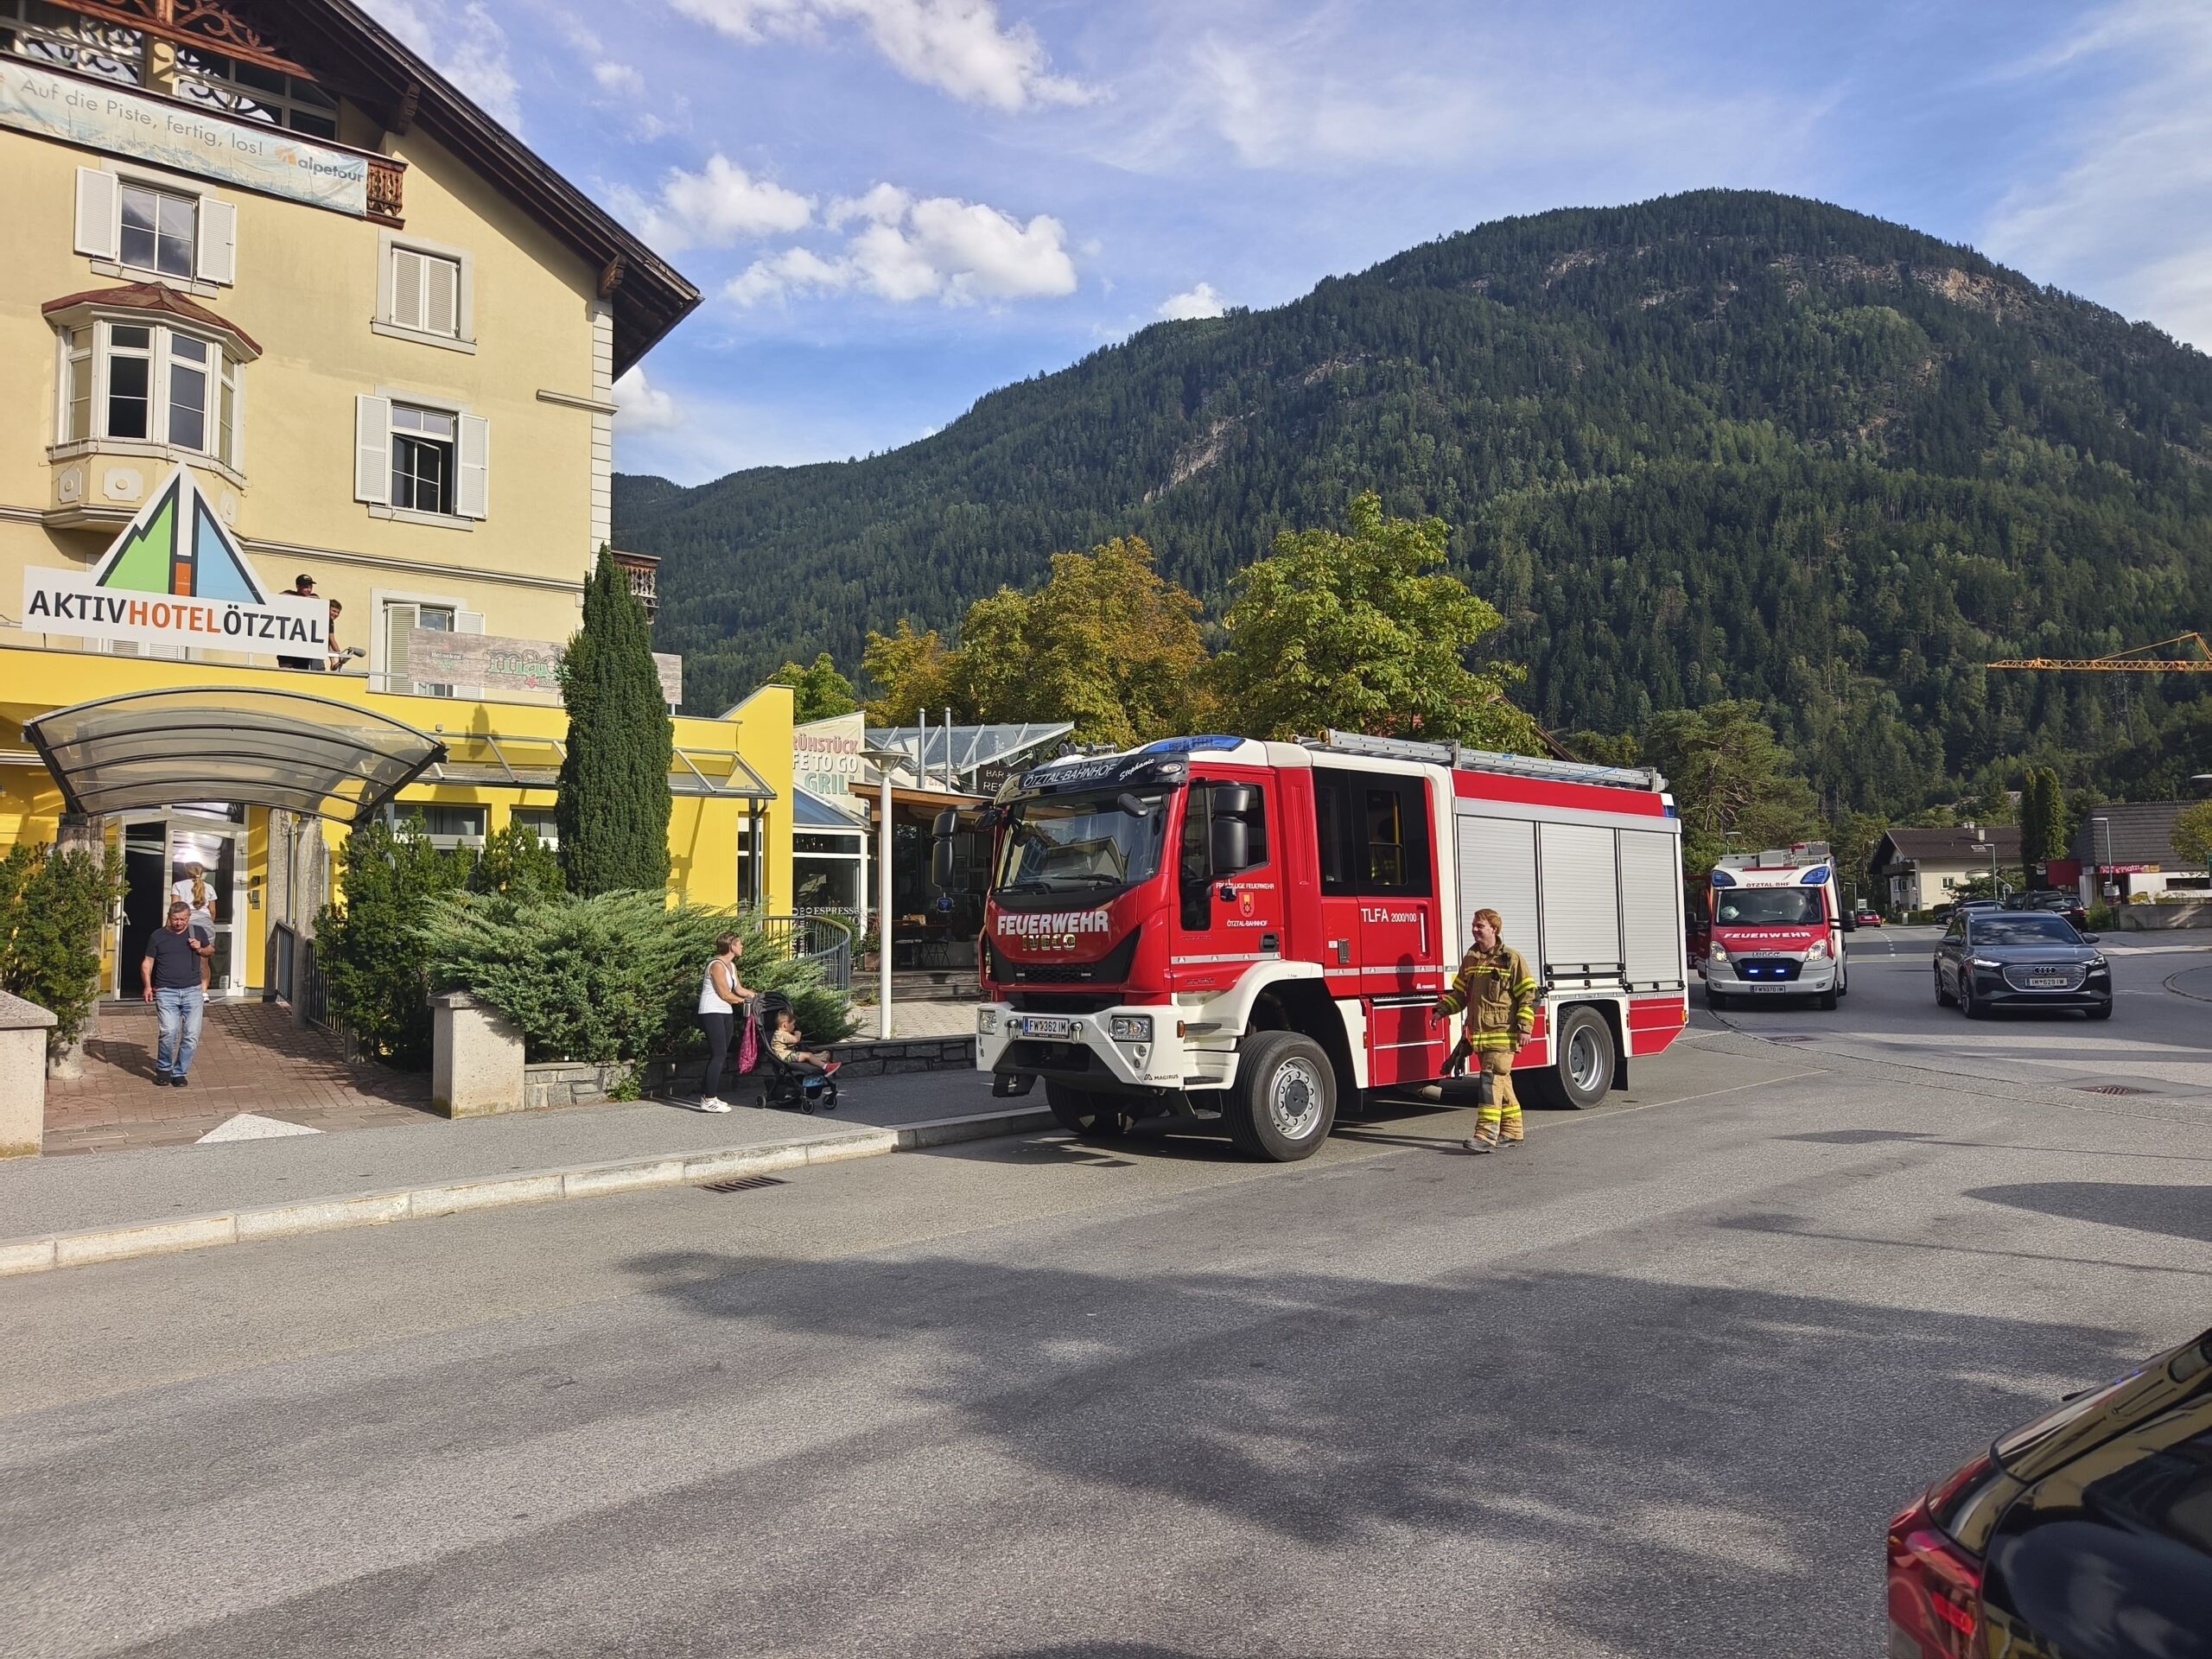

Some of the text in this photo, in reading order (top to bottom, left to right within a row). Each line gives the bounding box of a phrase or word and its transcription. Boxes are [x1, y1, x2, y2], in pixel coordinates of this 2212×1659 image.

[21, 79, 263, 156] Auf die Piste, fertig, los!
[298, 156, 364, 182] alpetour
[813, 754, 833, 772] TO
[836, 755, 859, 773] GO
[986, 769, 1004, 778] BAR
[1119, 759, 1155, 781] Stephanie
[1023, 764, 1117, 787] ÖTZTAL-BAHNHOF
[997, 911, 1109, 936] FEUERWEHR
[1361, 908, 1417, 923] TLFA 2000/100
[1022, 934, 1076, 950] IVECO
